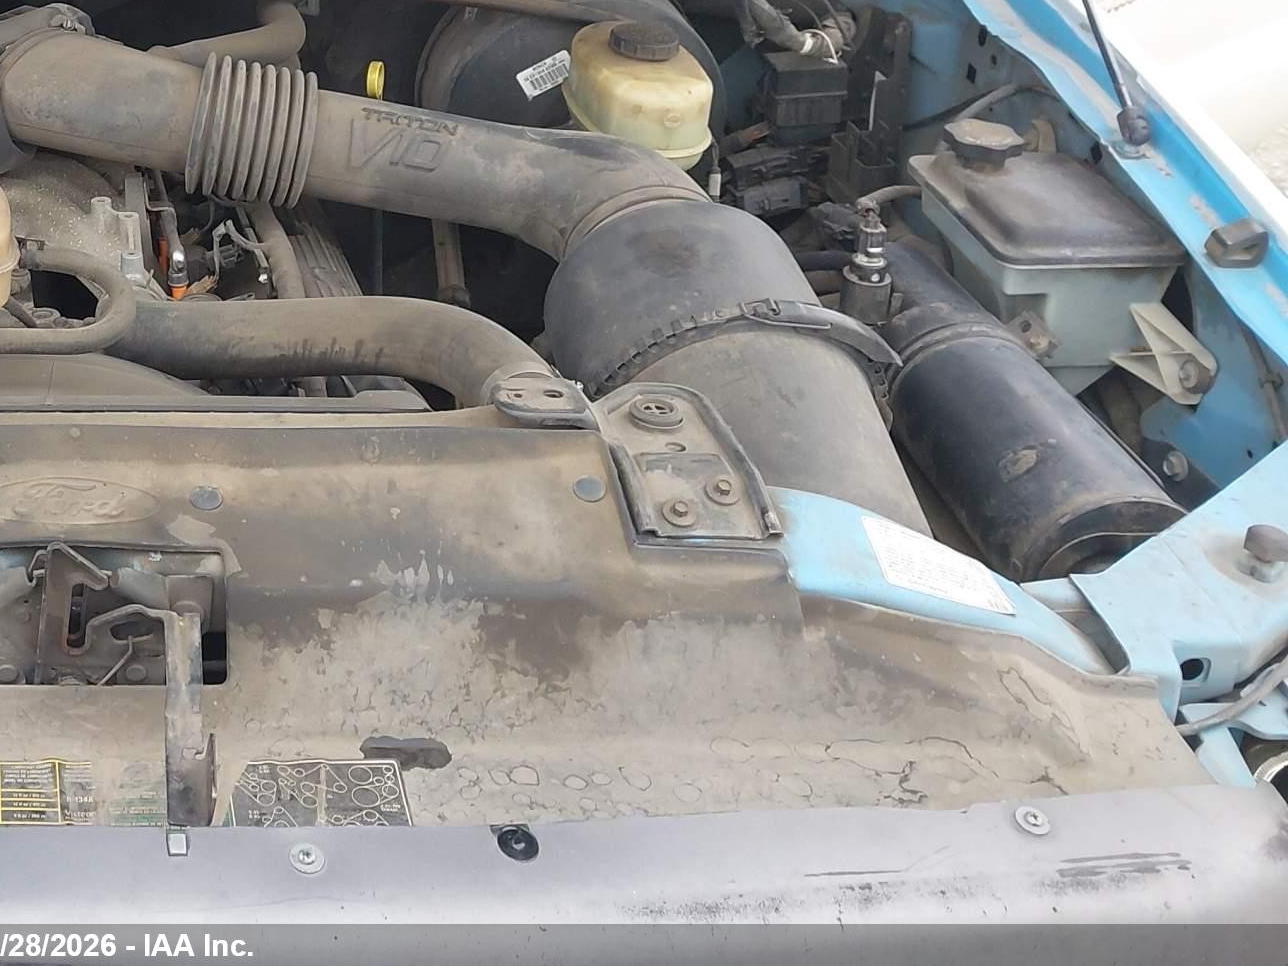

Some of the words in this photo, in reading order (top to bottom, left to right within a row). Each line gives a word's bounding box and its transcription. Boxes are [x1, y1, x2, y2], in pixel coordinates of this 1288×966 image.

[360, 106, 459, 136] TRITON
[347, 119, 443, 172] V10
[13, 481, 127, 518] Ford
